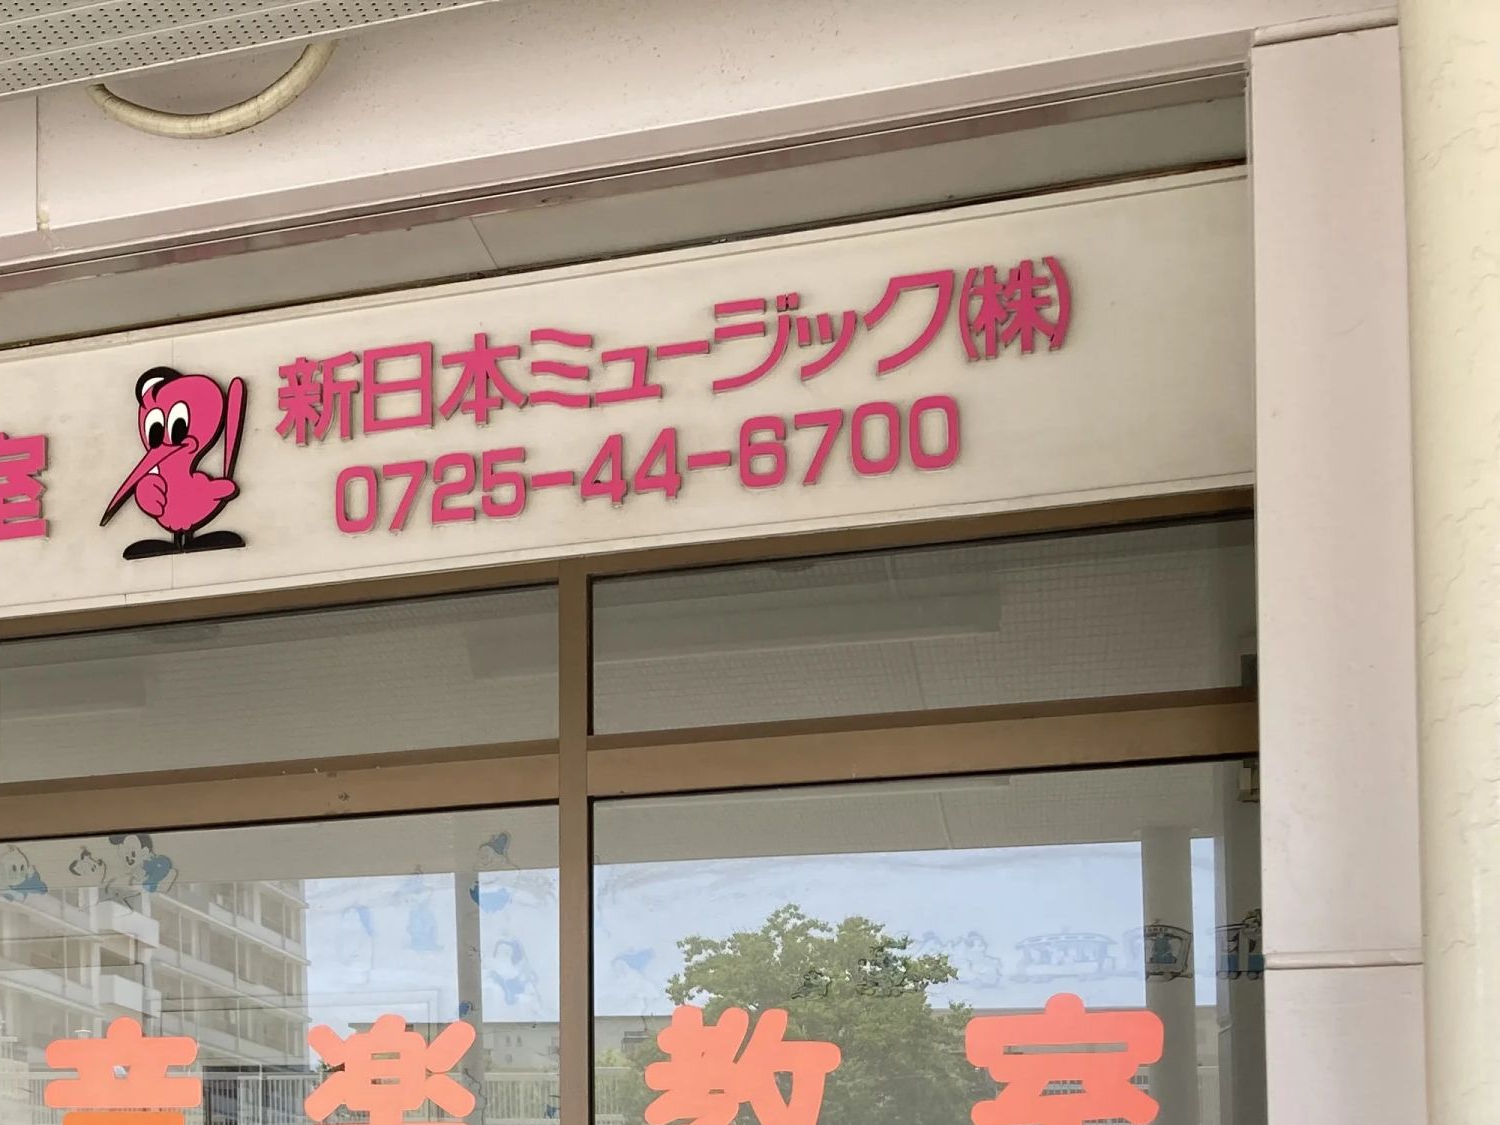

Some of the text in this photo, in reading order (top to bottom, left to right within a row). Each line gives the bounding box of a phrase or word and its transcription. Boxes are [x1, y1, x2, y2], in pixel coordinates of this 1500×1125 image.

[276, 257, 1071, 445] 新日本ミュージック(株)
[335, 396, 960, 533] 0725-44-6700
